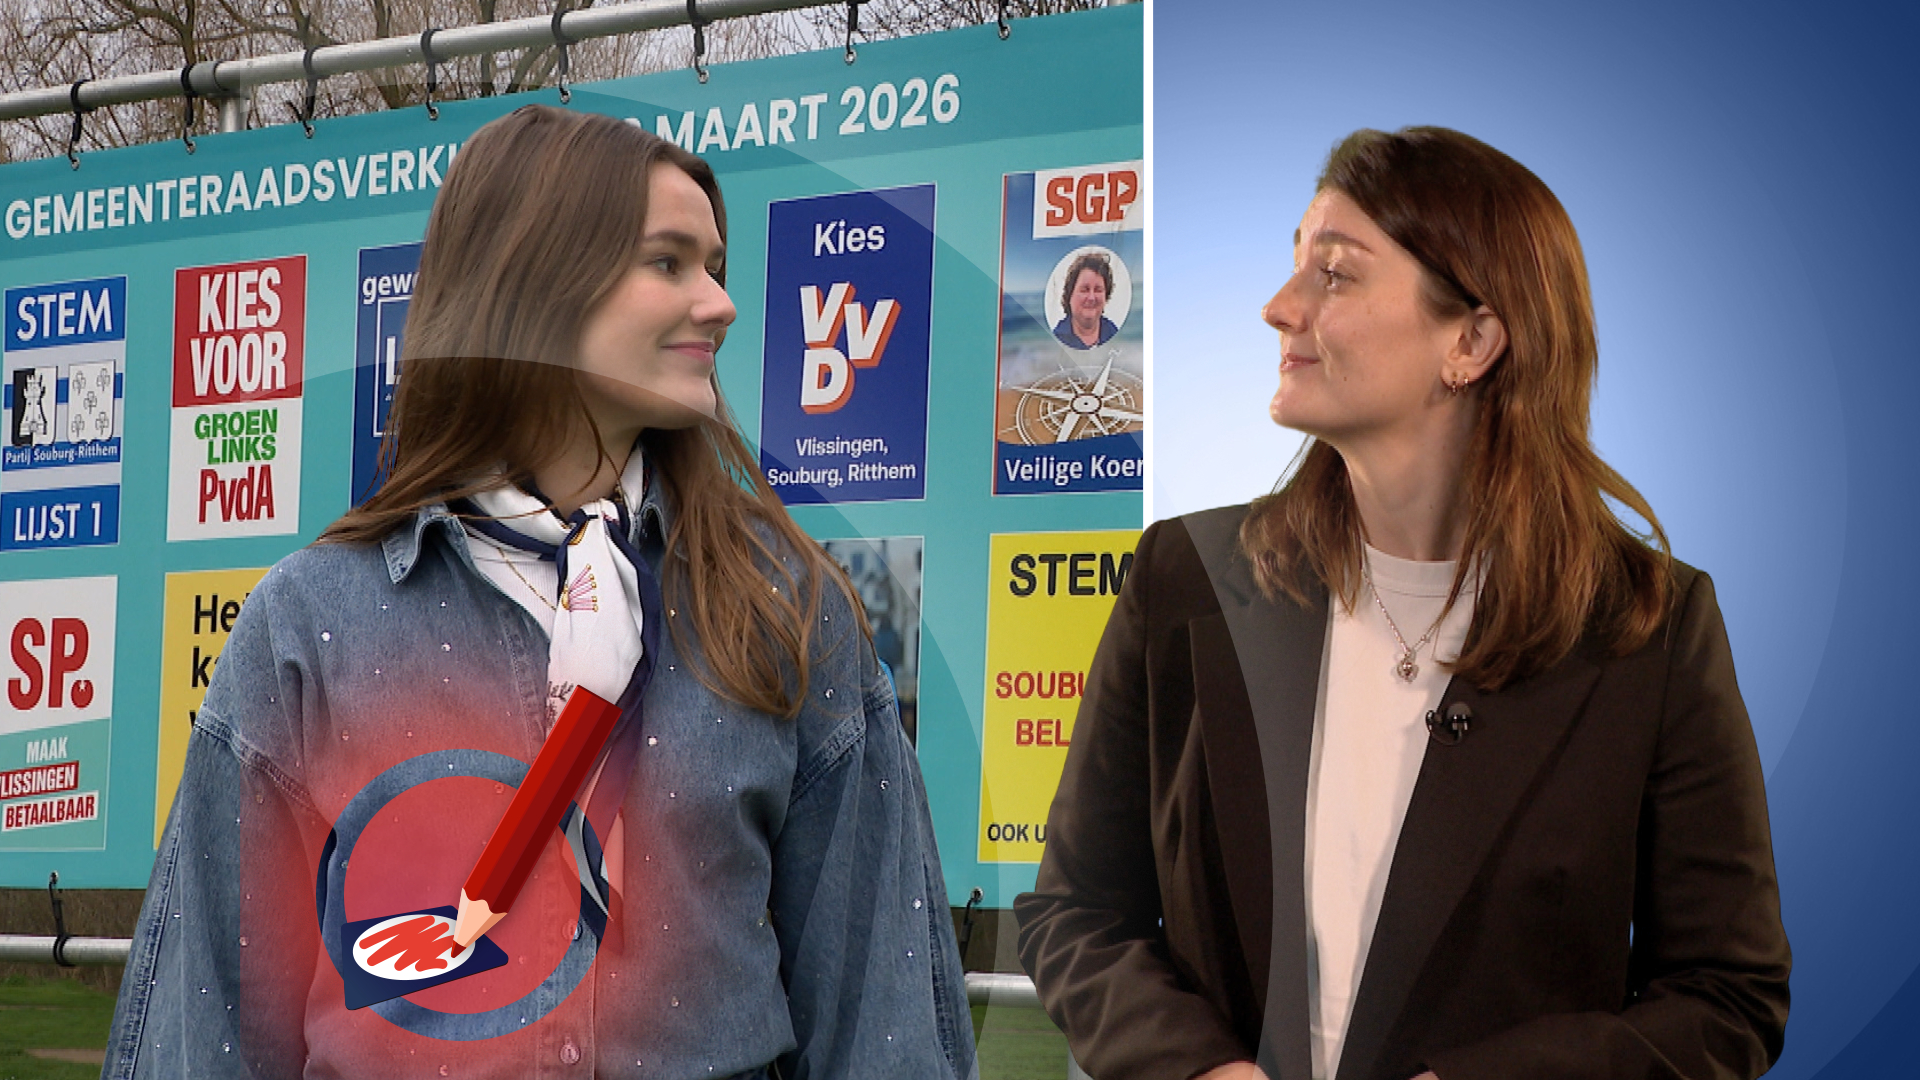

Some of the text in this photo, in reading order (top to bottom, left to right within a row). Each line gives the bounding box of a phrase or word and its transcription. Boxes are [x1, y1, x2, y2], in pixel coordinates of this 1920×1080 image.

[656, 92, 828, 154] MAART
[838, 73, 961, 135] 2026
[1046, 170, 1138, 227] SGP
[814, 219, 886, 257] Kies
[17, 288, 112, 342] STEM
[199, 267, 281, 332] KIES
[190, 331, 287, 397] VOOR
[194, 408, 278, 440] GROEN
[5, 443, 118, 465] Partij Souburg-Ritthem
[207, 435, 276, 465] LINKS
[795, 435, 889, 458] Vlissingen,
[768, 462, 916, 488] Souburg, Ritthem
[1005, 457, 1083, 486] Veilige
[199, 464, 275, 524] PvdA
[15, 501, 101, 541] LIJST 1
[1009, 553, 1134, 596] STEM
[193, 592, 251, 635] He
[26, 736, 68, 764] MAAK
[1016, 719, 1070, 747] BEL
[0, 764, 75, 798] LISSINGEN
[5, 795, 95, 830] BETAALBAAR
[988, 823, 1029, 843] OOK
